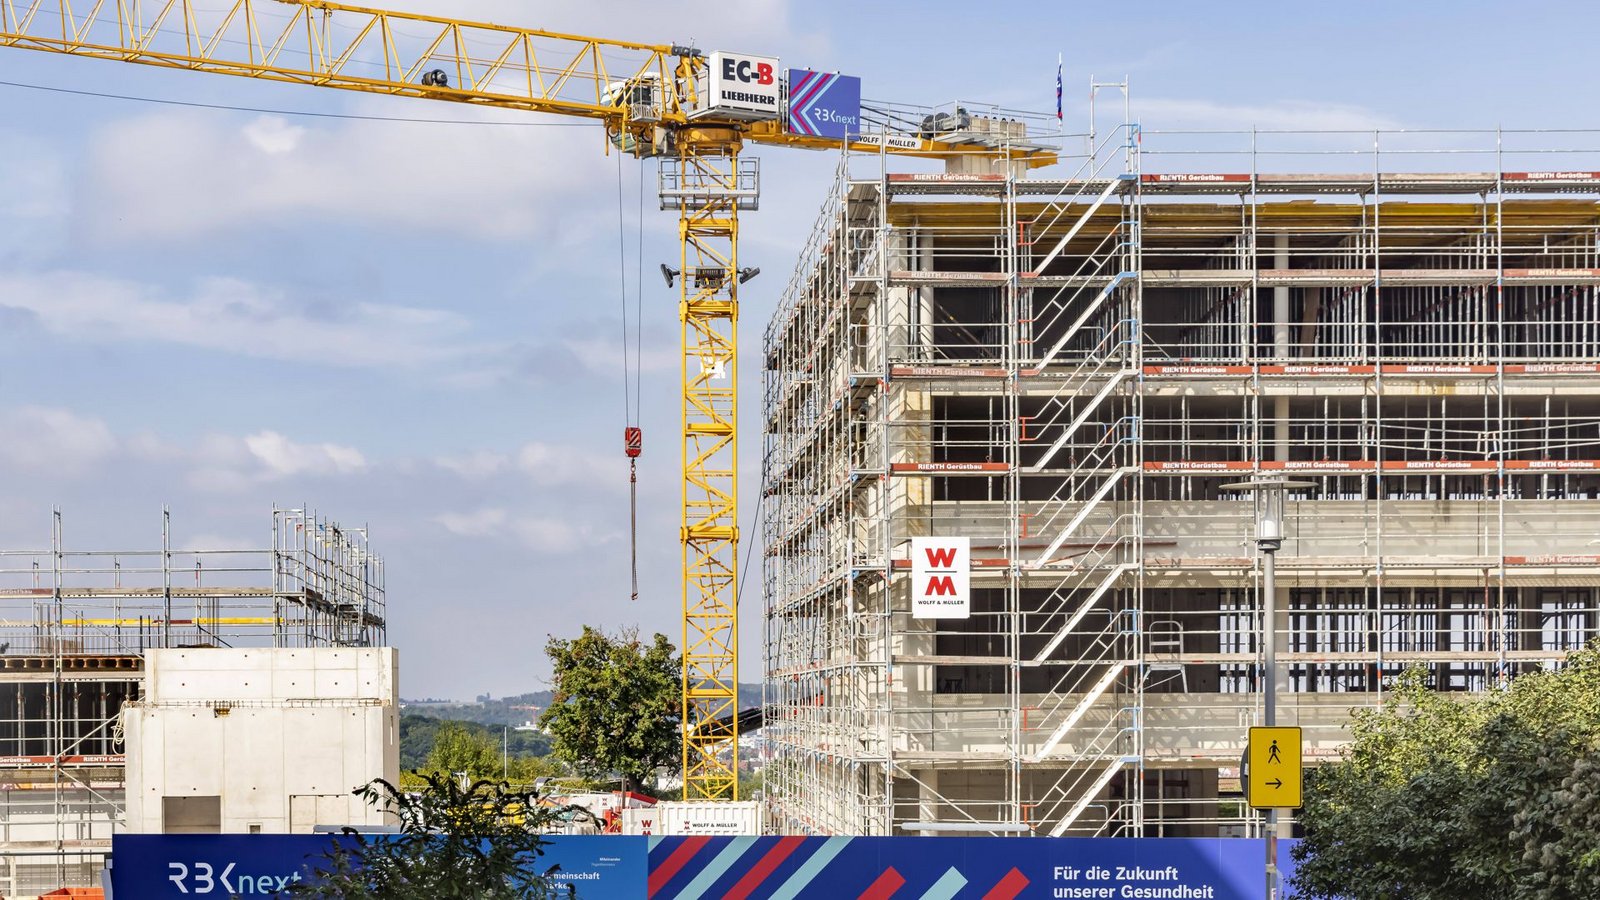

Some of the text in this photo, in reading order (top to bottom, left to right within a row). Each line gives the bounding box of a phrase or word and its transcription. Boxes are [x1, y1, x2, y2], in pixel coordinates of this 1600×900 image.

[722, 57, 774, 86] EC-B
[722, 90, 776, 106] LIEBHERR
[942, 172, 979, 180] Gerüstbau
[925, 548, 957, 568] W
[925, 576, 957, 596] M
[641, 820, 652, 828] W
[1054, 866, 1178, 880] Für die Zukunft
[1054, 885, 1214, 898] unserer Gesundheit
